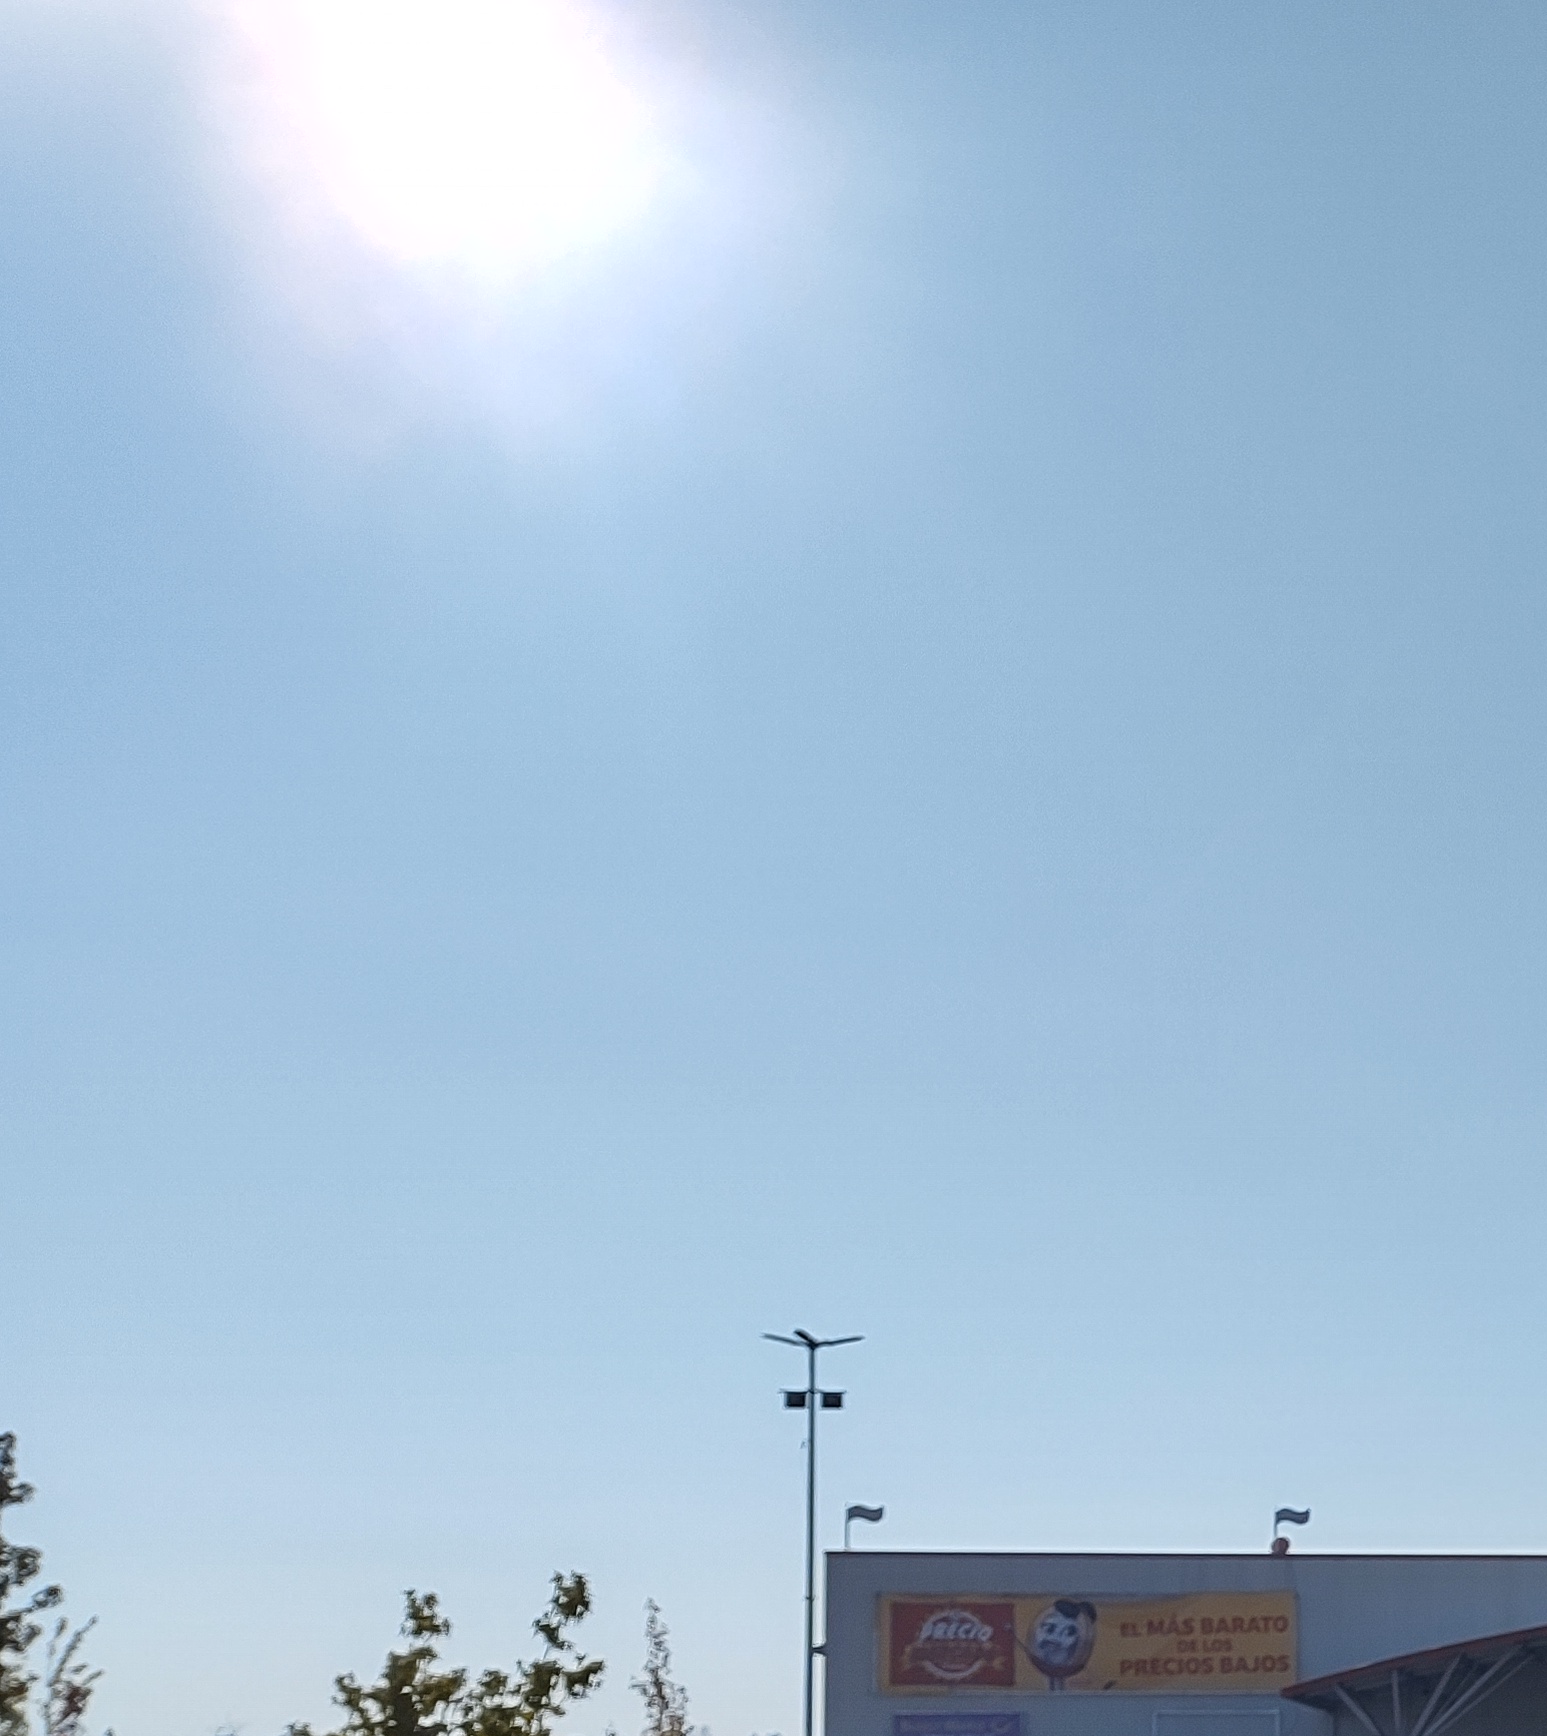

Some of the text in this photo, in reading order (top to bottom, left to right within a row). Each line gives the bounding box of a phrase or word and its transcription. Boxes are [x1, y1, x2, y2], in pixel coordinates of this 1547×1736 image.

[1120, 1613, 1289, 1638] EL MÁS BARATO
[1176, 1638, 1233, 1653] DE LOS
[1119, 1654, 1291, 1676] PRECIOS BAJOS
